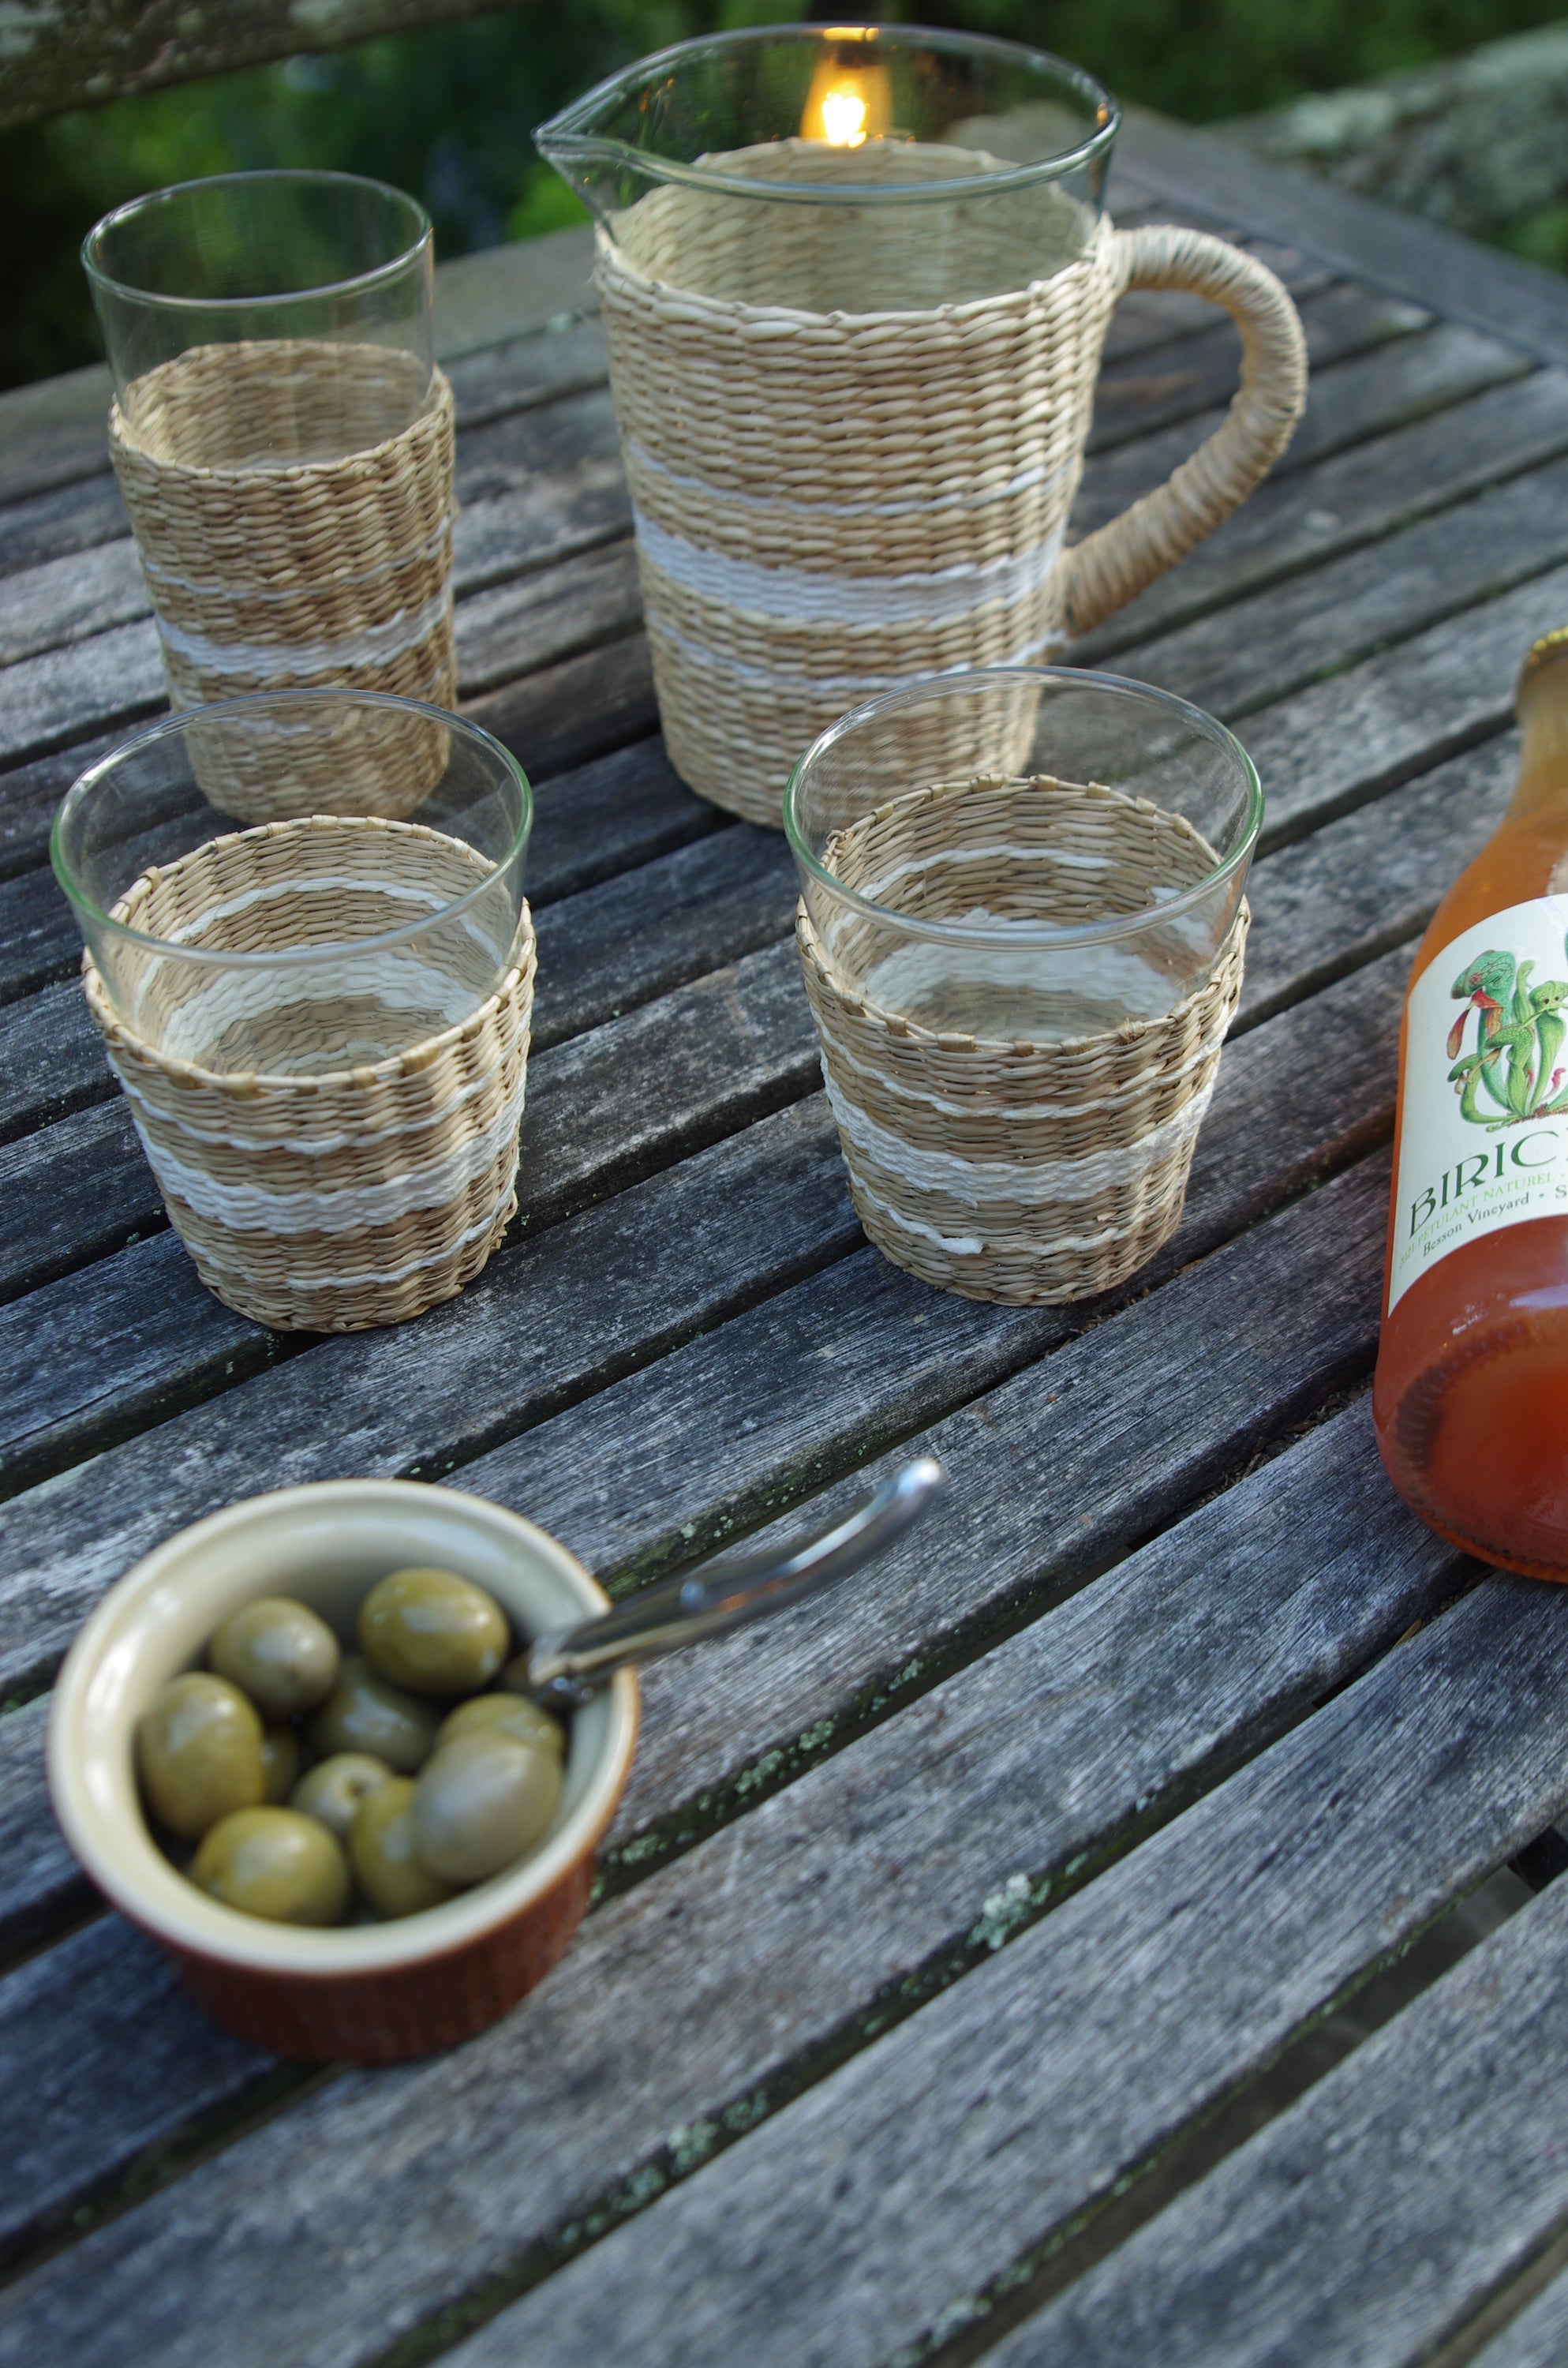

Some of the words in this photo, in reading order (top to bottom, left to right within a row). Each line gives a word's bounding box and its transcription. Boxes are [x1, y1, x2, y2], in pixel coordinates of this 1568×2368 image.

[1399, 1243, 1415, 1269] 2021
[1484, 1172, 1555, 1199] NATUREL
[1409, 1130, 1568, 1238] BIRIC
[1423, 1223, 1463, 1257] Besson
[1467, 1192, 1529, 1224] Vineyard
